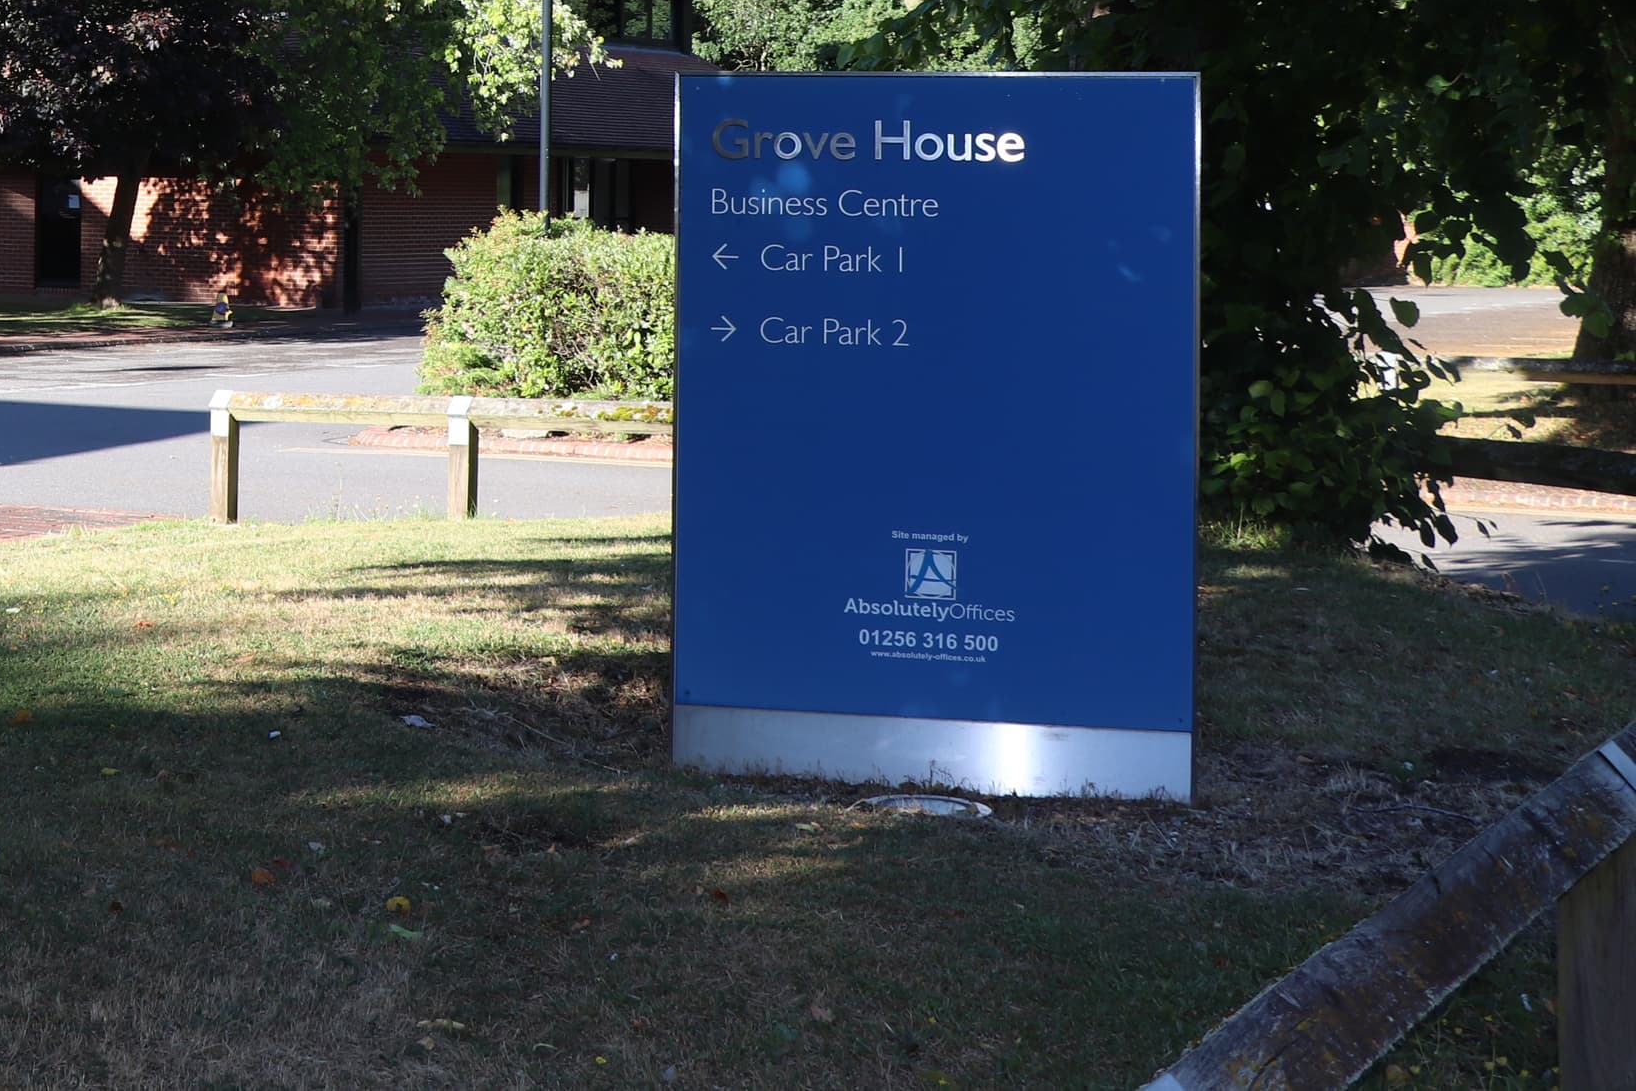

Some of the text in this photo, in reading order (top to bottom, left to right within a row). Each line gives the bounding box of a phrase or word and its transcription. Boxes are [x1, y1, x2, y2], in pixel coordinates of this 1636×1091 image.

[711, 118, 1025, 162] Grove House
[711, 188, 939, 217] Business Centre
[760, 244, 812, 272] Car
[823, 245, 882, 274] Park
[759, 316, 910, 347] Car Park 2
[891, 530, 969, 544] Site managed by
[844, 597, 1016, 622] AbsolutelyOffices
[859, 629, 998, 652] 01256 316 500
[870, 650, 987, 663] www.absolutely-offices.co.uk
